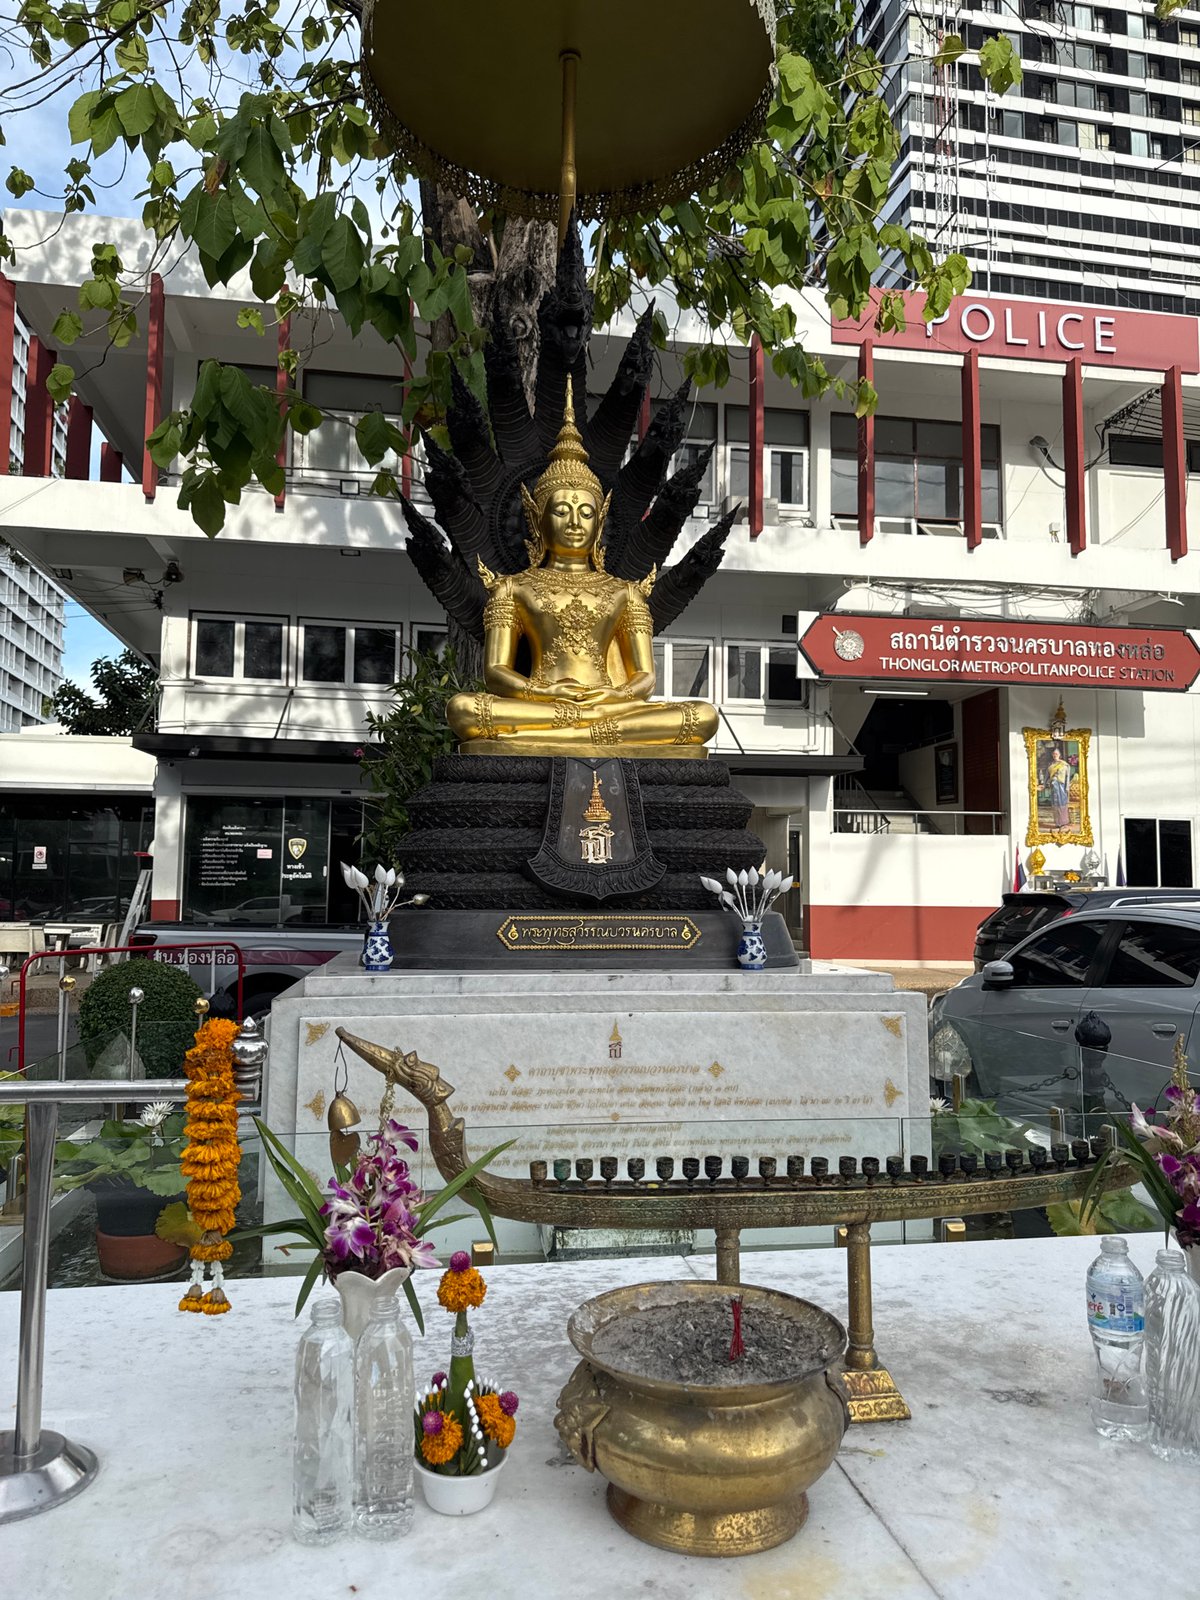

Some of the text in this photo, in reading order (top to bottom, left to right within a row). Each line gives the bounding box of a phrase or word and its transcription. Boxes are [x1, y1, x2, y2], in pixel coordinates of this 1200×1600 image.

[890, 625, 1165, 661] สถานีตำรวจนครบาลทองหล่อ
[880, 656, 1175, 683] THONGLOR METROPOLITAN POLICE STATION
